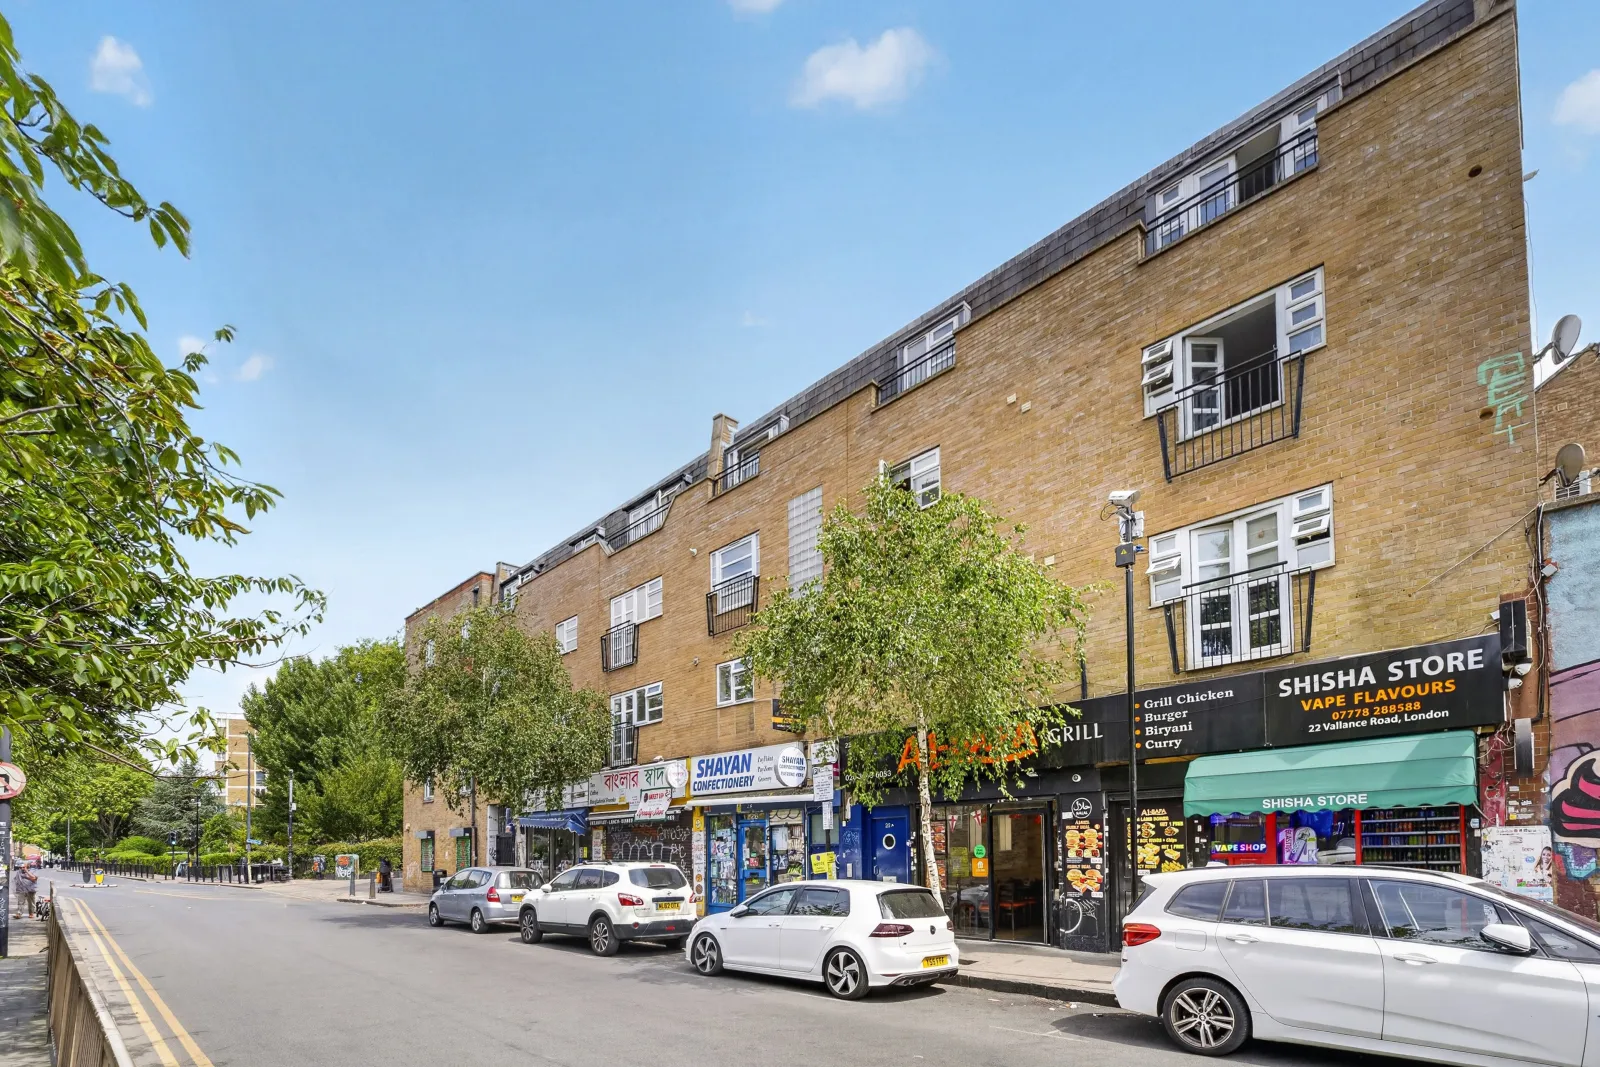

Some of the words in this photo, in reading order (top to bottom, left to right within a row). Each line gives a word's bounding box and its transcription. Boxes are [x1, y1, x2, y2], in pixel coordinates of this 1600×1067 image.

[1279, 666, 1376, 697] SHISHA
[1388, 649, 1484, 681] STORE
[1144, 697, 1172, 709] Grill
[1177, 689, 1234, 704] Chicken
[1301, 694, 1346, 711] VAPE
[1354, 679, 1456, 704] FLAVOURS
[1145, 710, 1188, 723] Burger
[1332, 708, 1369, 720] 07778
[1373, 702, 1421, 715] 288588
[1145, 722, 1193, 737] Biryani
[1308, 724, 1321, 733] 22
[1323, 719, 1368, 731] Vallance
[1370, 715, 1401, 726] Road,
[1404, 710, 1449, 722] London
[1048, 723, 1103, 744] GRILL
[1145, 738, 1182, 750] Curry
[697, 753, 752, 778] SHAYAN
[781, 755, 804, 765] SHAYAN
[604, 770, 639, 791] বাংলার
[875, 770, 892, 778] 6053
[693, 775, 754, 792] CONFECTIONERY
[1262, 797, 1313, 809] SHISHA
[1317, 794, 1368, 805] STORE
[1215, 844, 1238, 852] VAPE
[1240, 843, 1266, 851] SHOP
